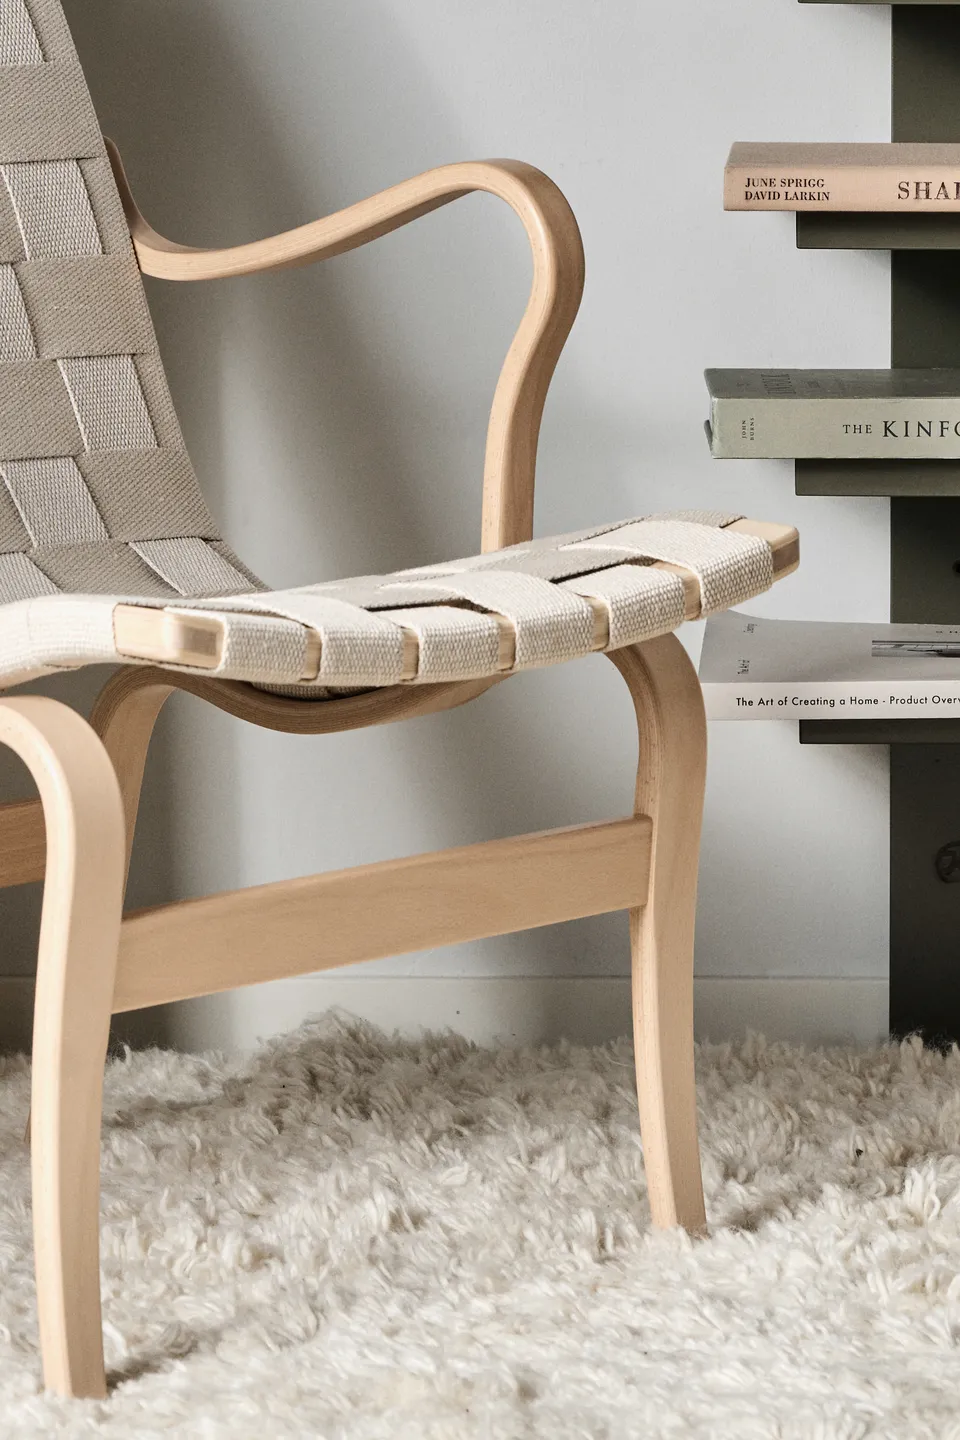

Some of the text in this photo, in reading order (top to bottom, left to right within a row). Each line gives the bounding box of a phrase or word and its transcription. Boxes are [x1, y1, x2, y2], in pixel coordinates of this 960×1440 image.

[745, 177, 825, 188] JUNE SPRIGG
[744, 191, 830, 201] DAVID LARKIN
[842, 424, 873, 434] THE
[735, 696, 754, 707] The
[757, 696, 774, 707] Art
[777, 695, 788, 707] of
[791, 696, 836, 708] Creating
[839, 698, 846, 706] a
[849, 696, 879, 706] Home
[889, 694, 928, 705] Product
